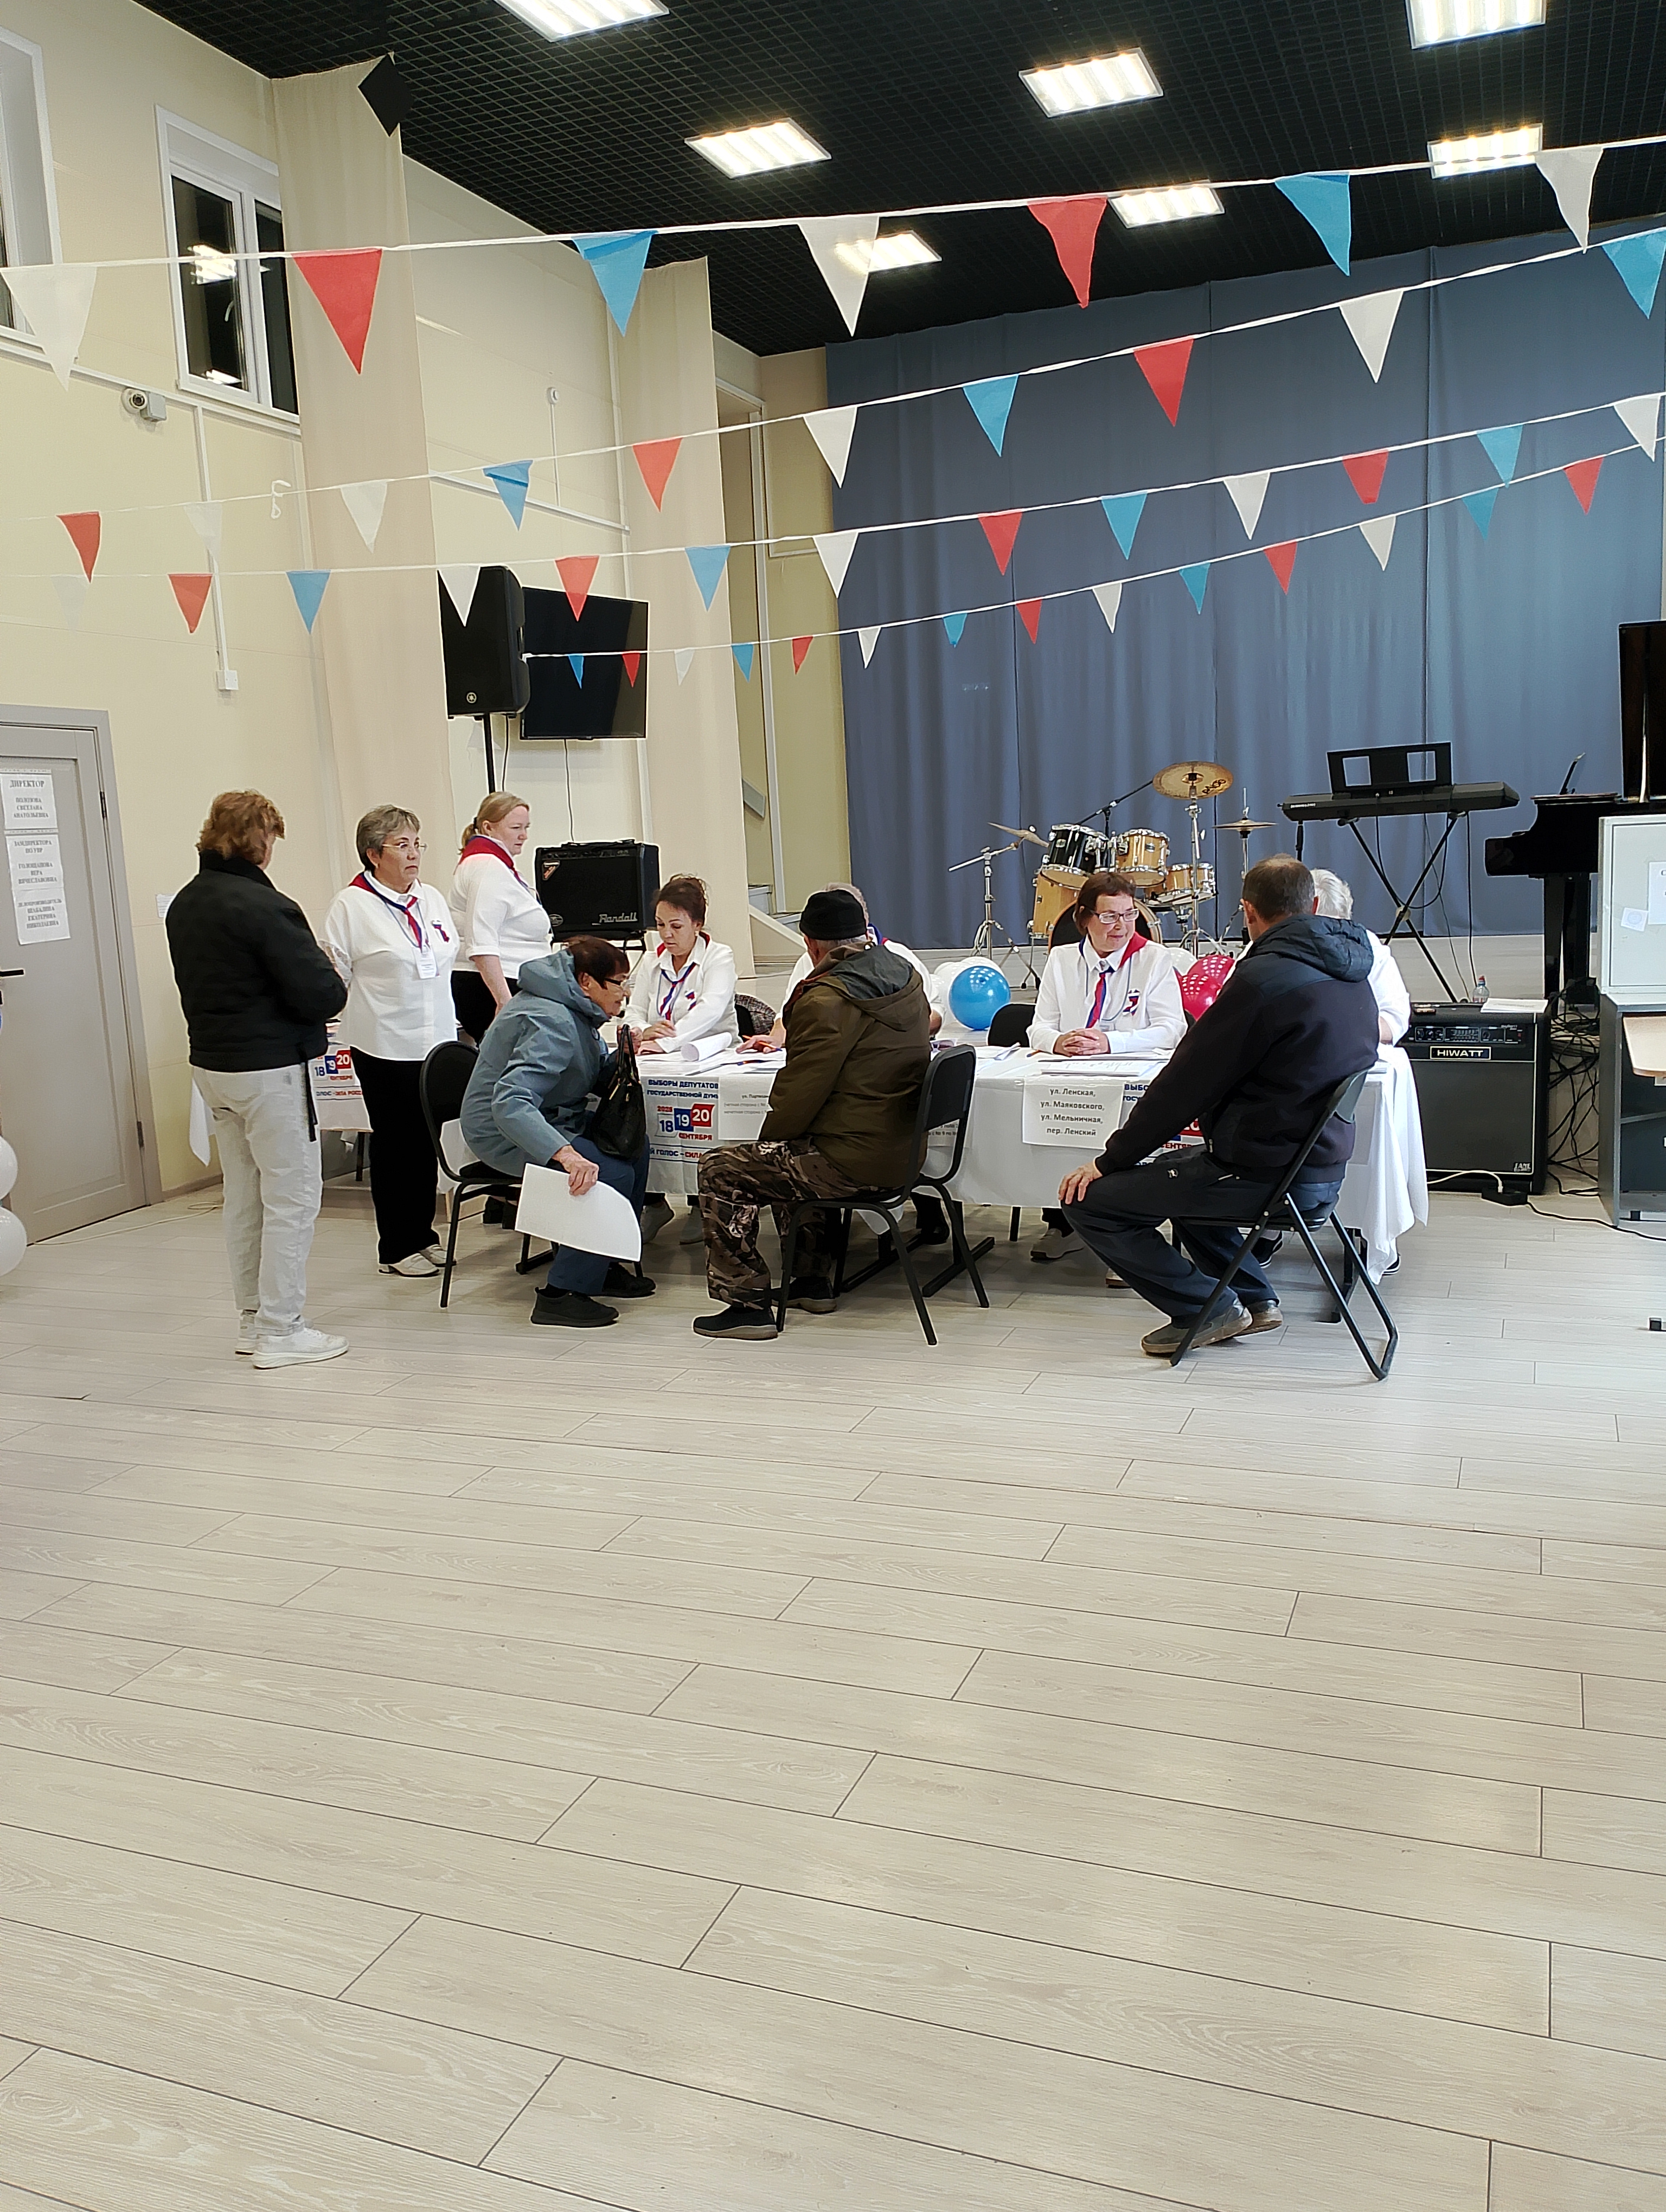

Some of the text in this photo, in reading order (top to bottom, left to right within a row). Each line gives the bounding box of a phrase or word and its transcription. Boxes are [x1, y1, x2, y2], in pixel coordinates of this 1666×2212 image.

[10, 780, 44, 788] ДИРЕКТОР
[599, 912, 638, 923] Randall
[336, 1054, 350, 1065] 20
[315, 1066, 325, 1076] 18
[679, 1081, 719, 1089] ДЕПУТАТОВ
[647, 1089, 702, 1098] ГОСУДАРСТВЕННОЙ
[1062, 1089, 1096, 1097] Ленская,
[1053, 1101, 1105, 1110] Маяковского,
[692, 1109, 710, 1122] 20
[1054, 1114, 1103, 1124] Мельничная,
[676, 1114, 690, 1127] 19
[659, 1120, 674, 1133] 18
[1064, 1128, 1096, 1136] Ленский
[678, 1133, 712, 1141] СЕНТЯБРЯ
